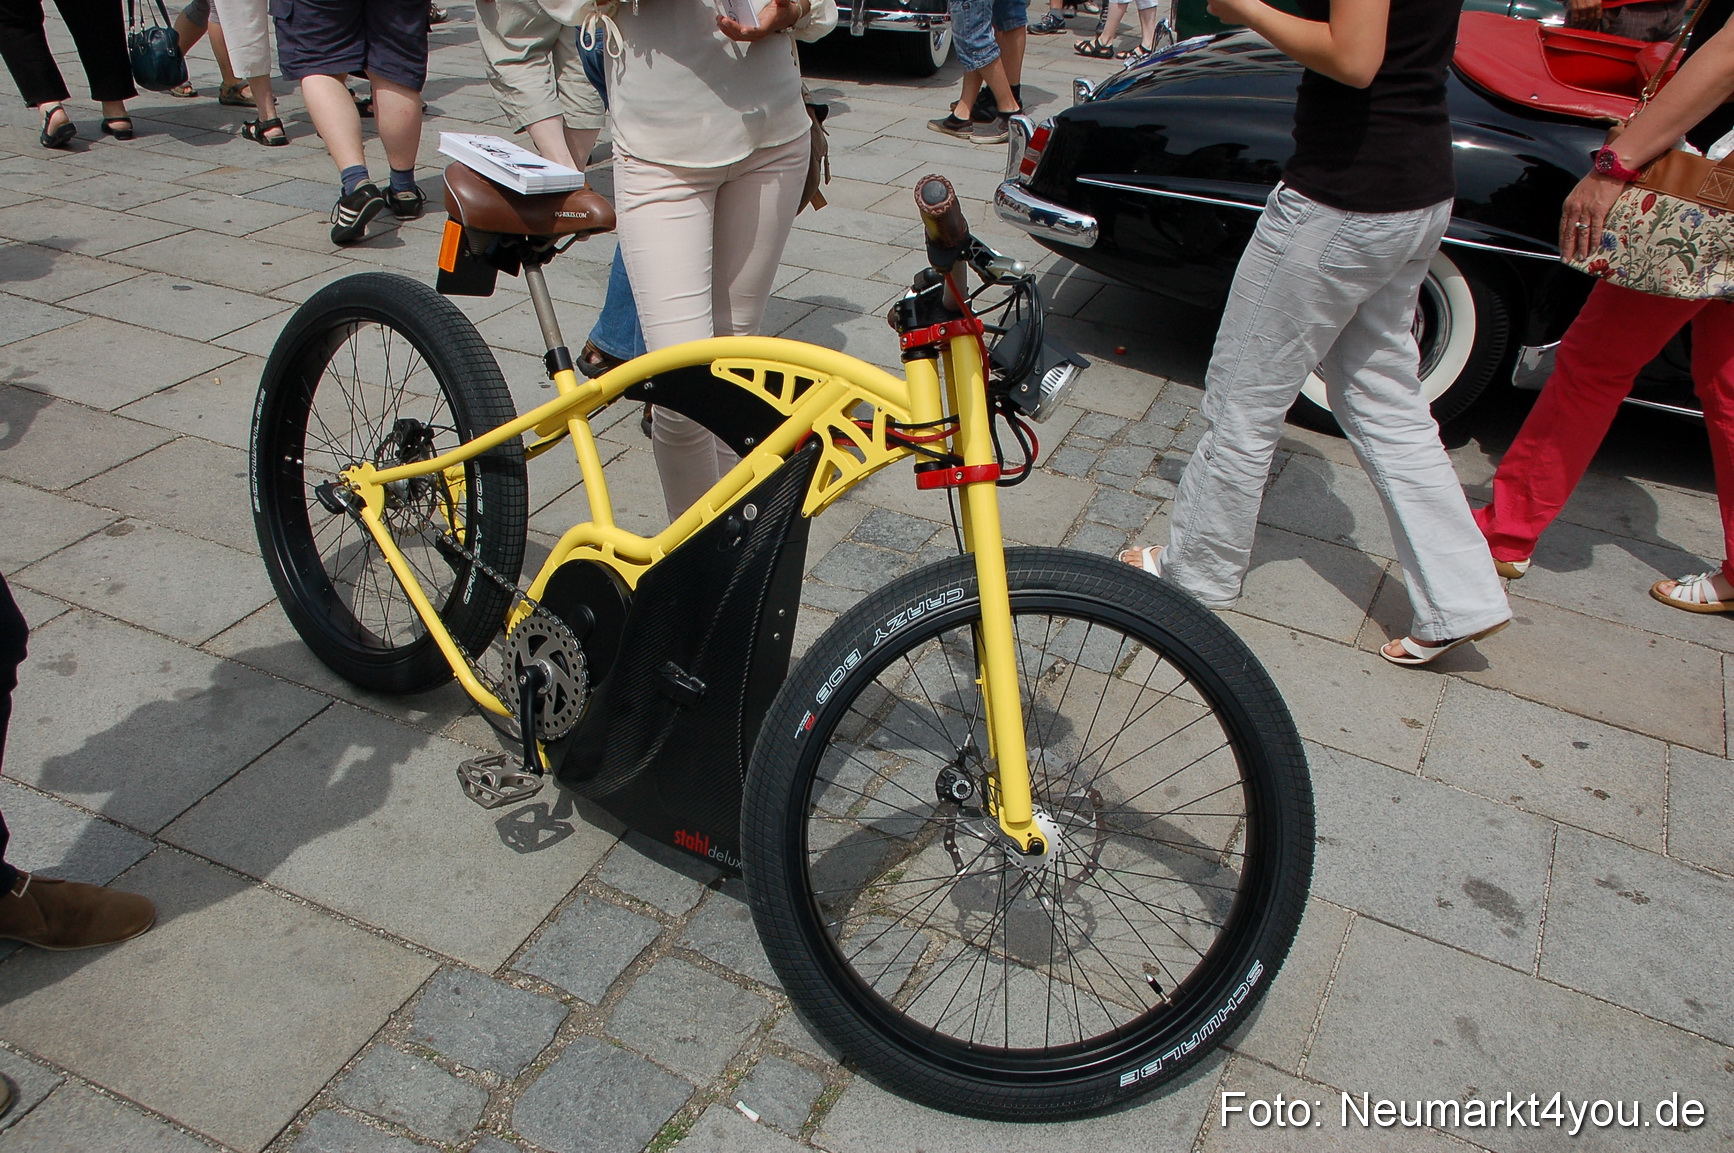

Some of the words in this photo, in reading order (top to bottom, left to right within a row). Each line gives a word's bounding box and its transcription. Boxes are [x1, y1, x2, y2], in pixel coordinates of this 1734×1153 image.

[251, 388, 266, 512] SCHWALBE
[473, 460, 484, 515] BOB
[873, 587, 964, 646] CRAZY
[816, 648, 862, 704] BOB
[674, 829, 743, 869] stahldelux
[1119, 959, 1264, 1087] SCHWALBE
